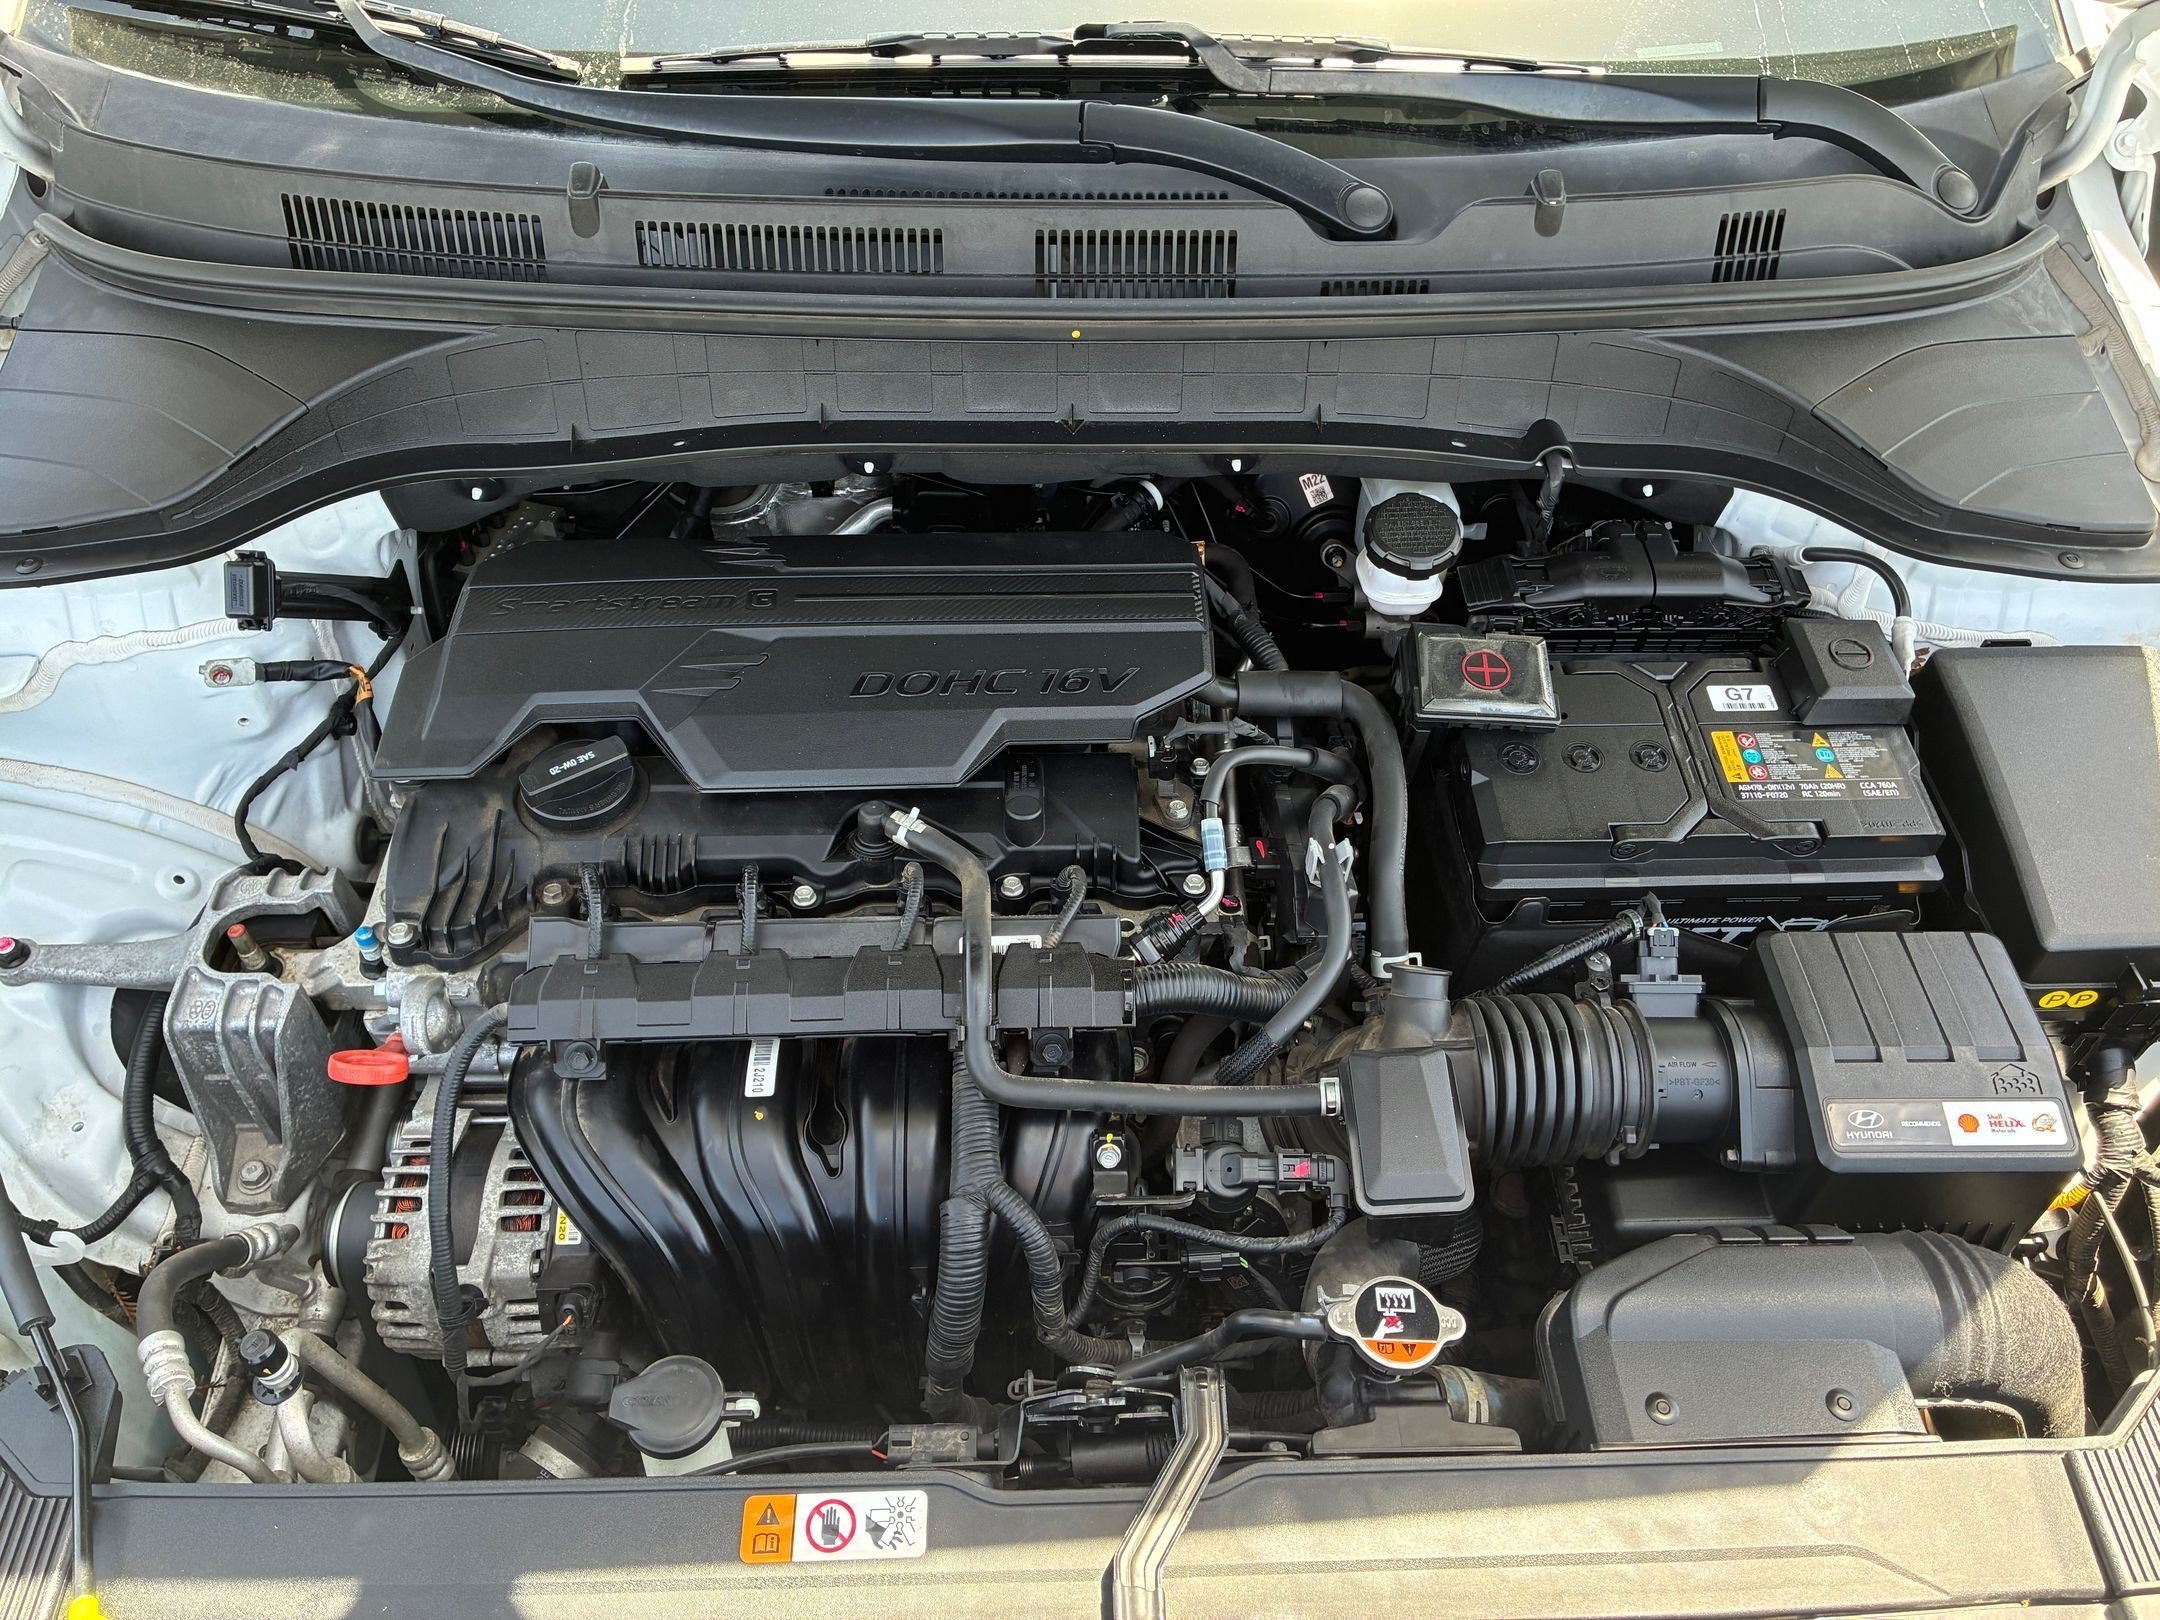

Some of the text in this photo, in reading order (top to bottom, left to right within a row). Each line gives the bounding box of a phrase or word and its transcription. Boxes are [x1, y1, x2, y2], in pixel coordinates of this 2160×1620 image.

[849, 667, 1141, 698] DOHC 16V
[1725, 687, 1753, 701] G7
[549, 751, 595, 775] SAE 0W-20
[1820, 782, 1846, 790] (20HR)
[1877, 781, 1897, 789] 760A
[1721, 916, 1765, 924] POWER
[752, 1067, 766, 1093] 2J210
[1846, 1130, 1893, 1139] HYUNDAI
[1989, 1118, 2025, 1128] HELIX
